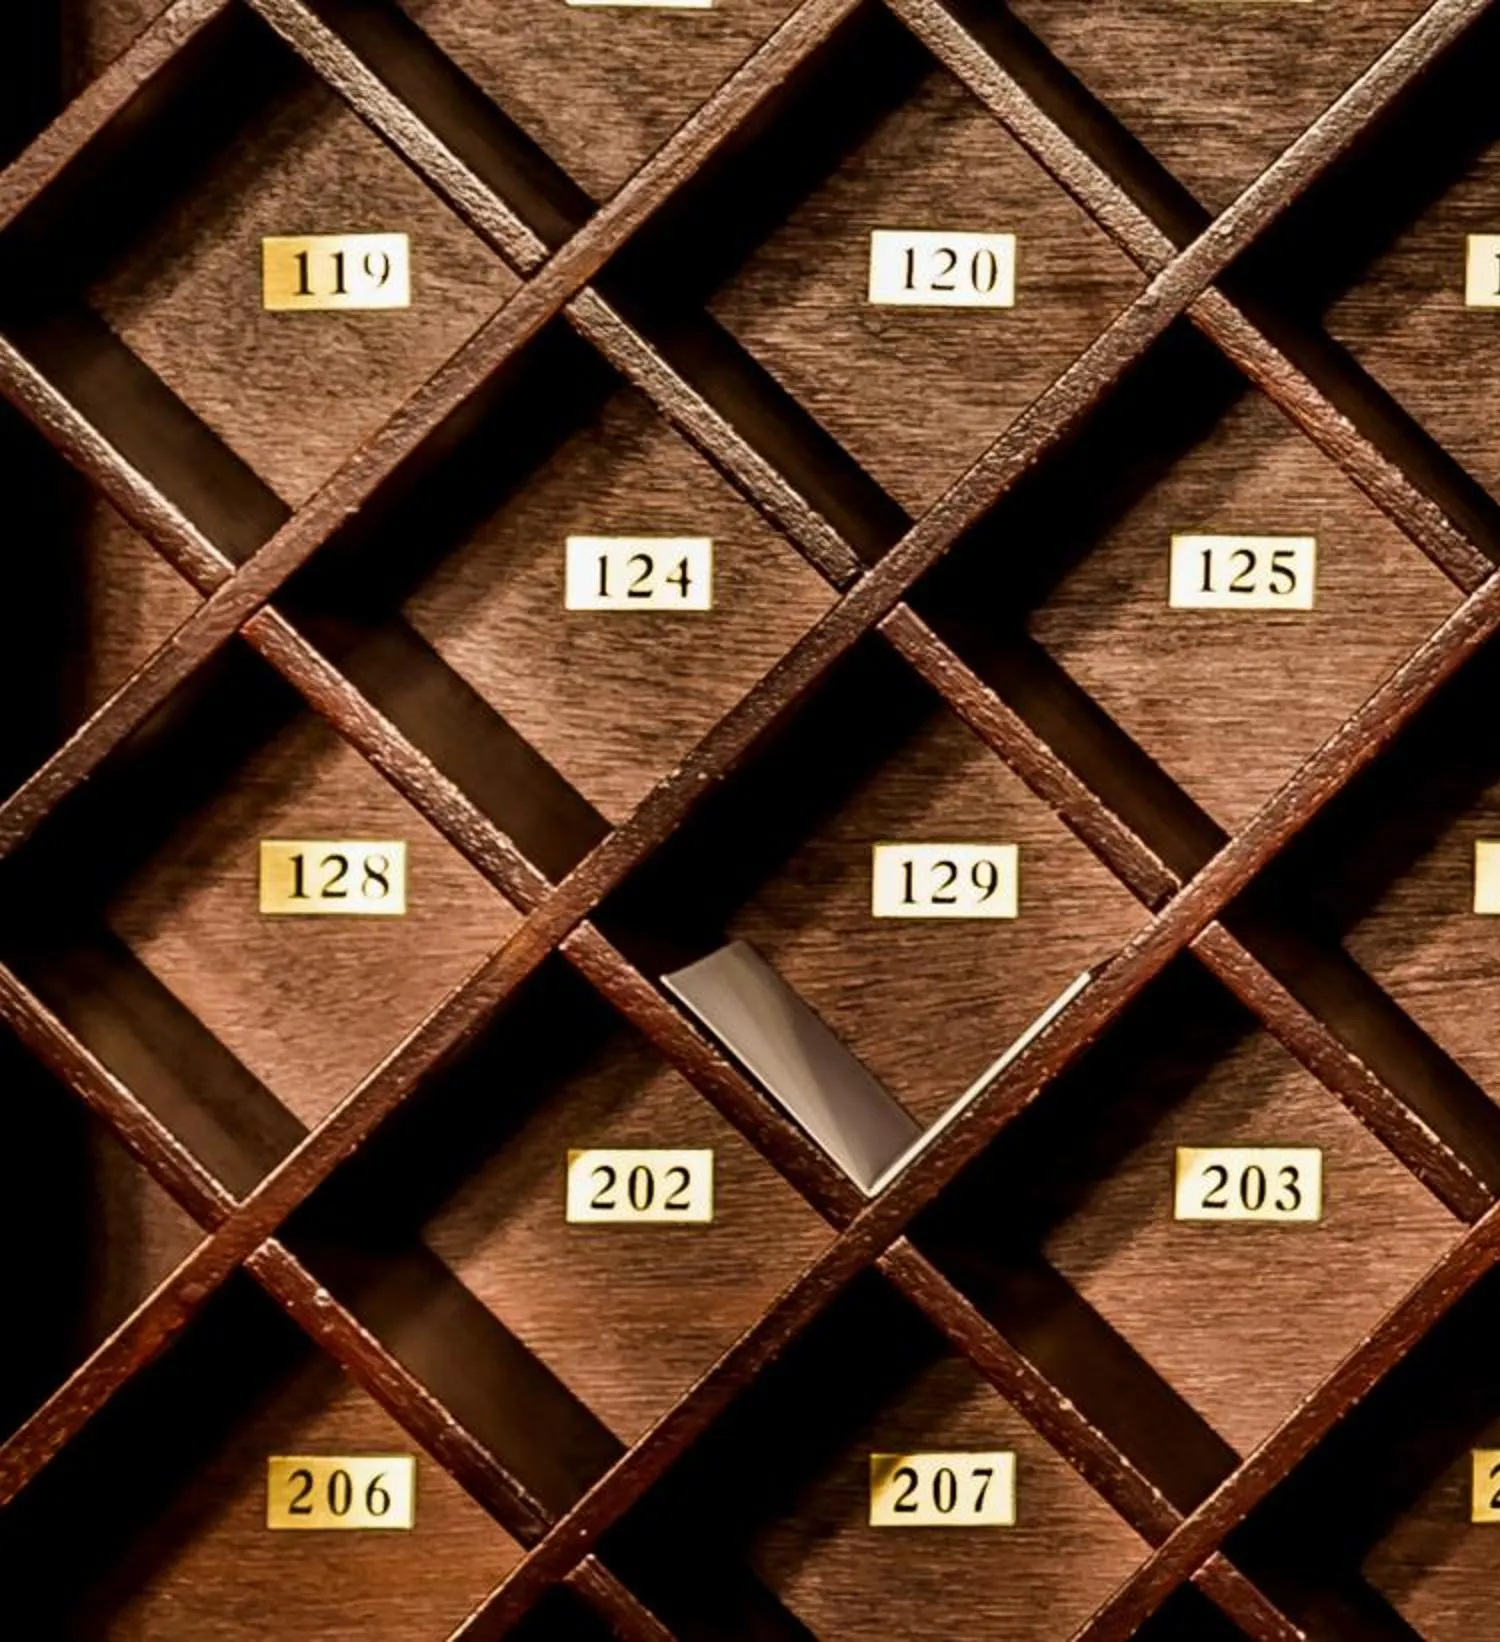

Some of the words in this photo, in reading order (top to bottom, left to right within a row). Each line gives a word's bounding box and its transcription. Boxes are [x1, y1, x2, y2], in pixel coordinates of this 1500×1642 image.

[294, 251, 389, 296] 119
[906, 248, 997, 290] 120
[599, 554, 691, 597] 124
[1202, 549, 1296, 592] 125
[290, 854, 388, 898] 128
[903, 861, 998, 904] 129
[594, 1166, 690, 1210] 202
[1204, 1165, 1301, 1210] 203
[288, 1468, 390, 1515] 206
[893, 1467, 992, 1513] 207
